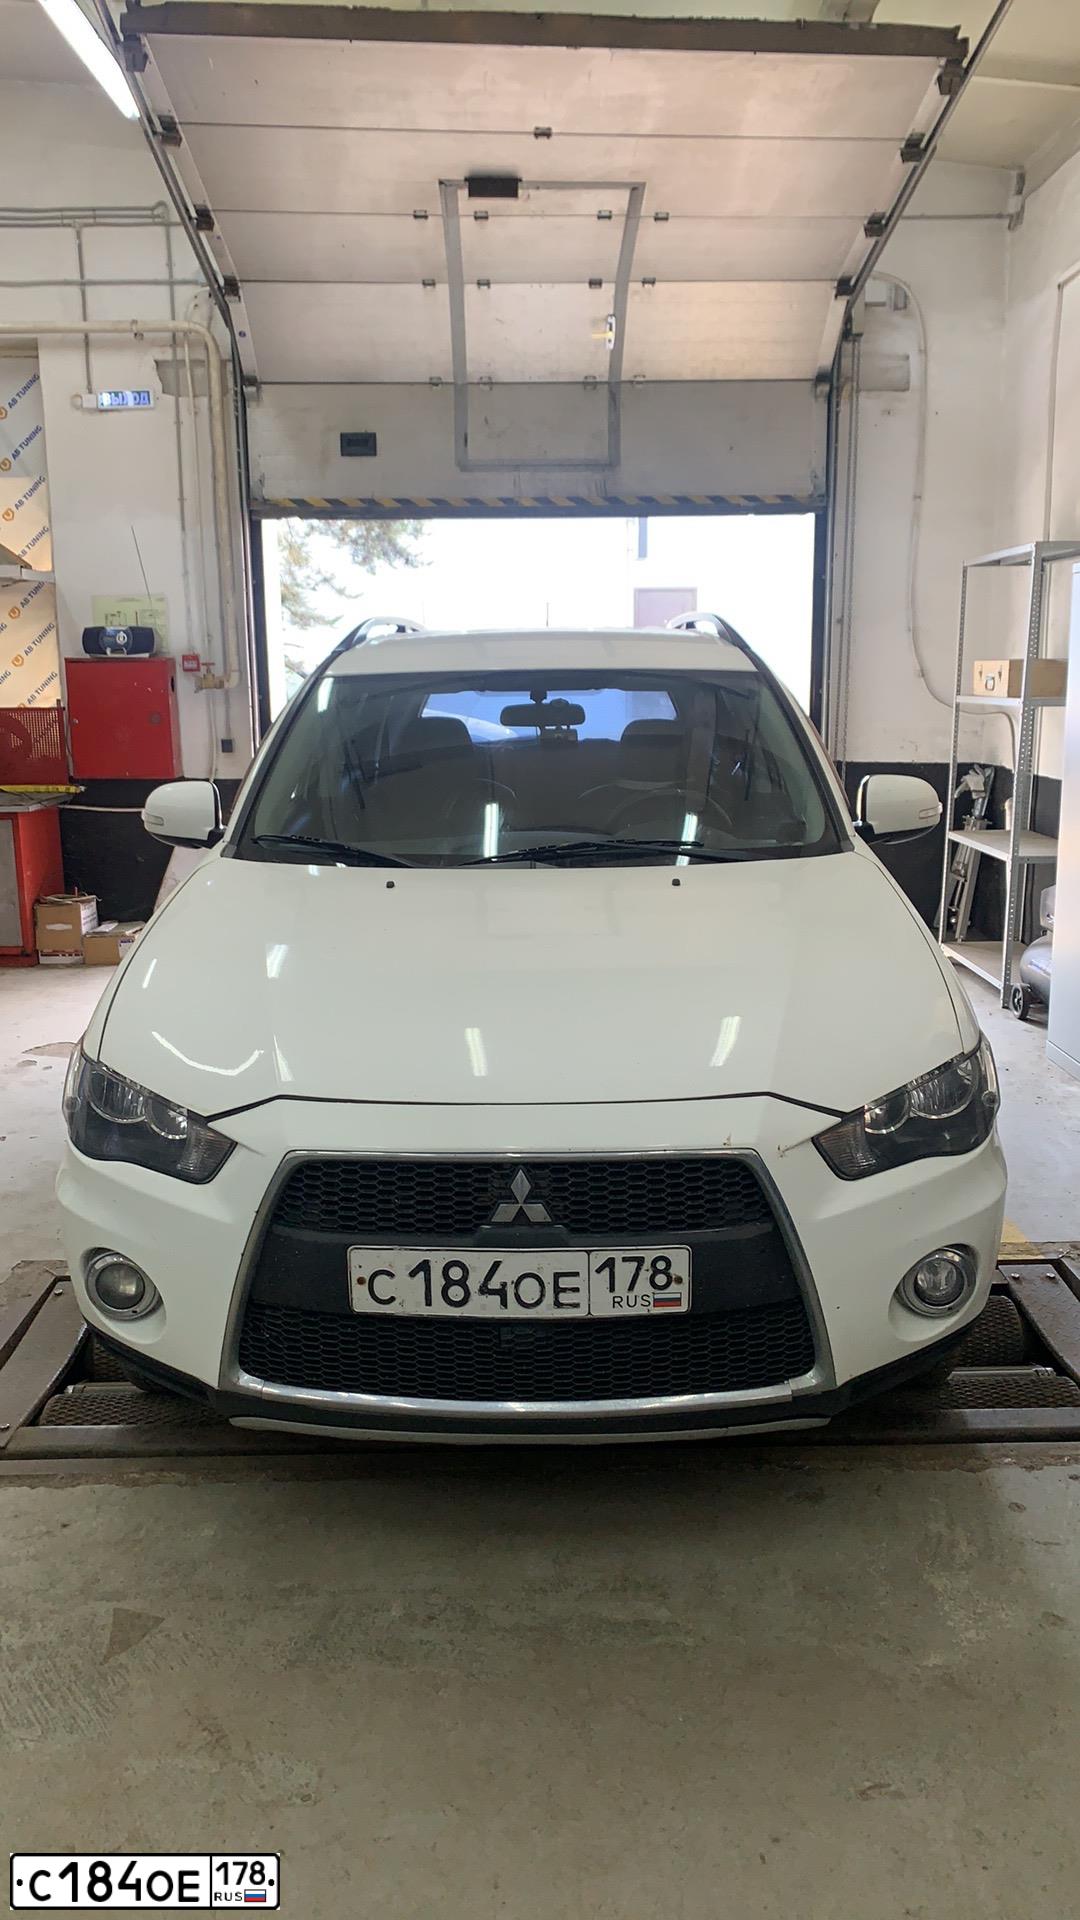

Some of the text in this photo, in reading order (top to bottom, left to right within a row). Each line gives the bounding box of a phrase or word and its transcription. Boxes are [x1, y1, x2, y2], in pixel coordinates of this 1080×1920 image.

[8, 373, 40, 409] AB TUNING
[11, 424, 42, 460] AB TUNING
[14, 475, 46, 510] AB TUNING
[25, 525, 49, 550] TUNING
[20, 597, 31, 608] AB
[24, 622, 55, 656] AB TUNING
[27, 671, 58, 705] AB TUNING
[595, 1255, 673, 1293] 178
[612, 1294, 651, 1309] RUS
